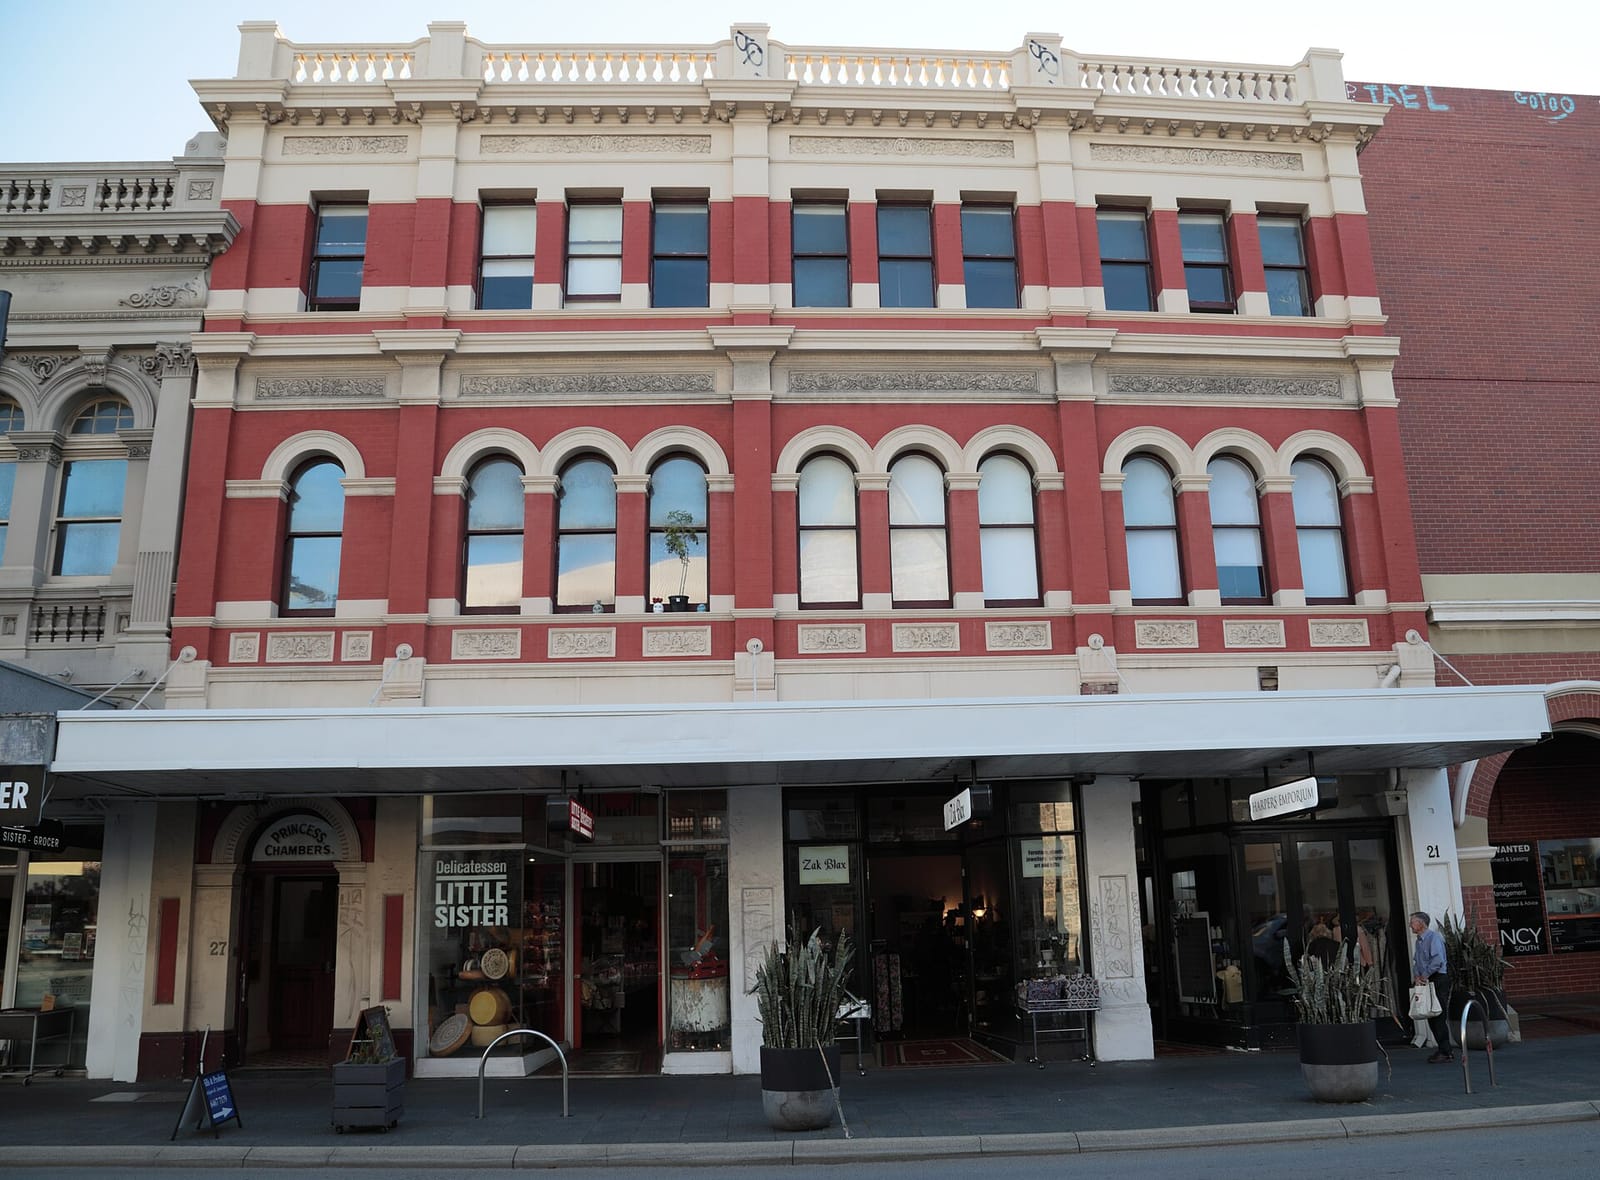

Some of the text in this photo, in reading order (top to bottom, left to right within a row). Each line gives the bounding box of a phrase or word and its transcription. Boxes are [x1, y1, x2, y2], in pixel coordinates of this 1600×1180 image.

[1279, 787, 1314, 806] EMPORIUM
[2, 832, 26, 843] SISTER
[34, 836, 60, 848] GROCER
[1427, 845, 1440, 858] 21
[436, 860, 507, 874] Delicatessen
[802, 858, 846, 870] Zak Blax
[435, 882, 508, 904] LITTLE
[435, 905, 508, 927] SISTER
[210, 942, 227, 955] 27
[1514, 944, 1540, 952] SOUTH
